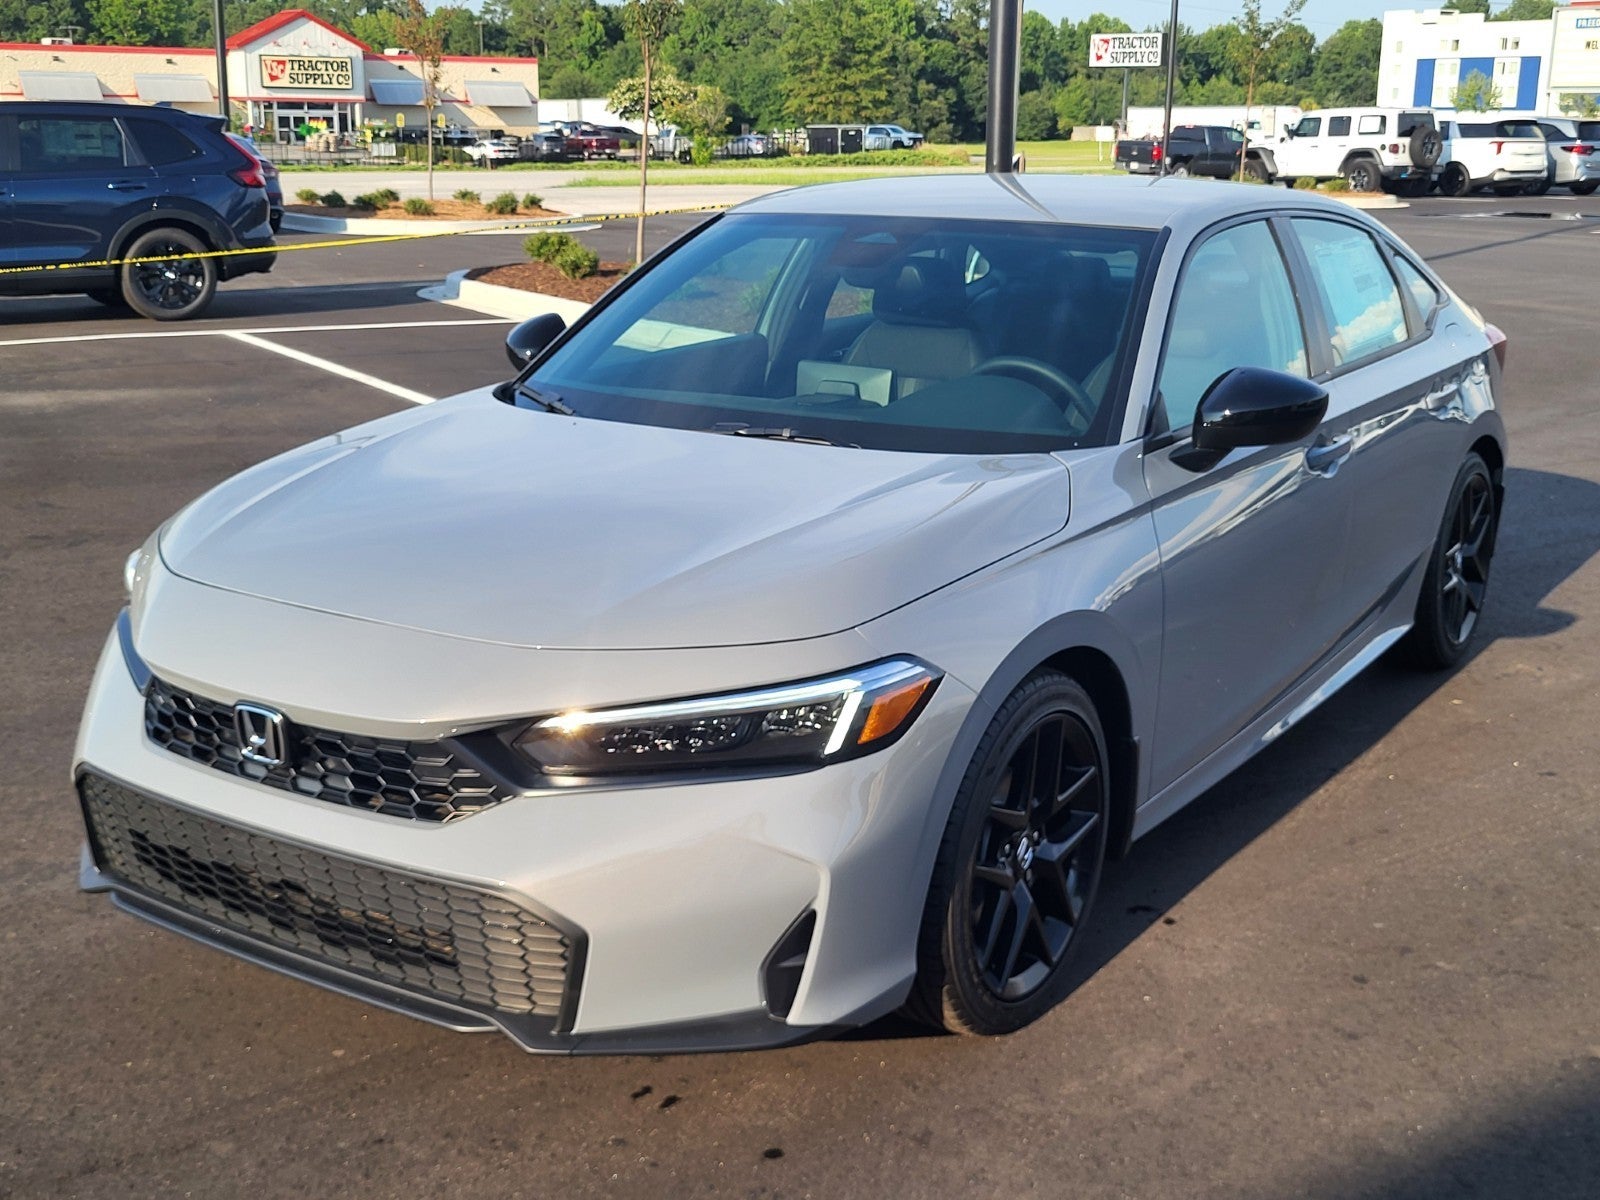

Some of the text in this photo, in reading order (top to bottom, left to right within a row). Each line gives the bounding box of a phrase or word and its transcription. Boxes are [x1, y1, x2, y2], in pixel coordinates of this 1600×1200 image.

[1111, 36, 1158, 49] TRACTOR
[1110, 51, 1146, 64] SUPPLY
[289, 59, 348, 72] TRACTOR
[289, 73, 334, 85] SUPPLY
